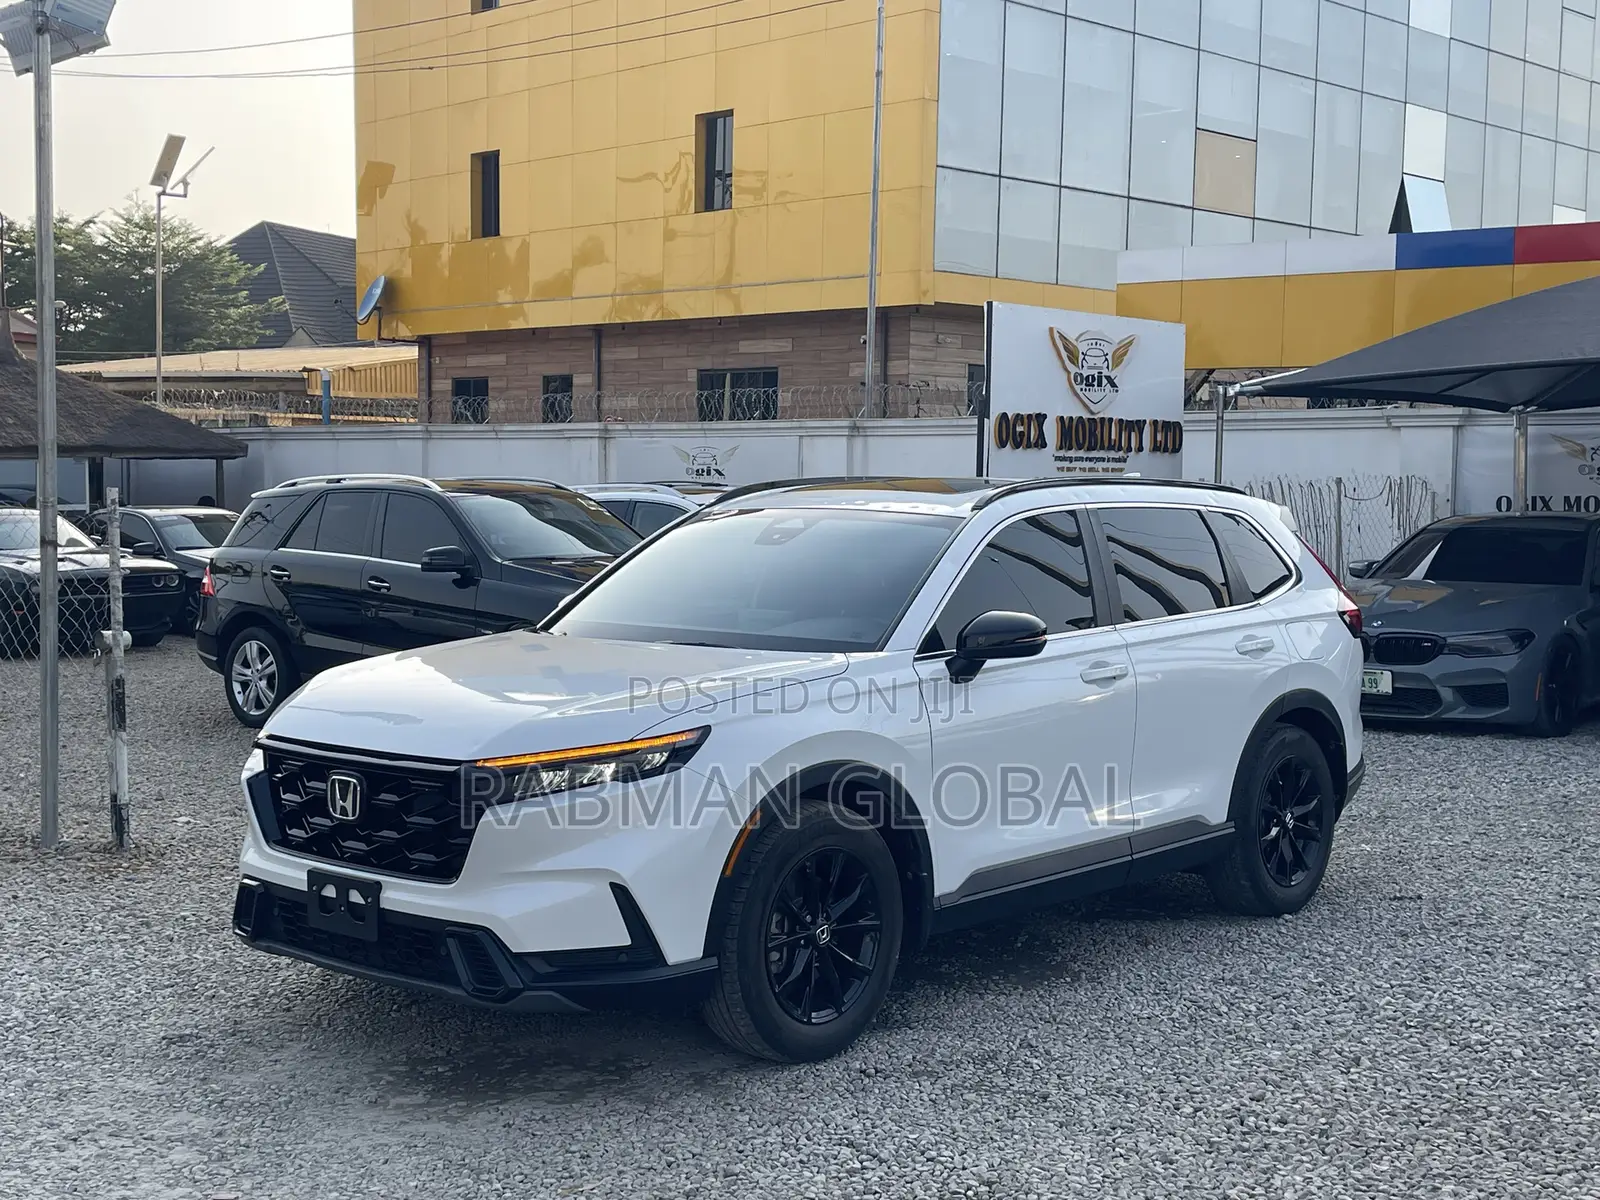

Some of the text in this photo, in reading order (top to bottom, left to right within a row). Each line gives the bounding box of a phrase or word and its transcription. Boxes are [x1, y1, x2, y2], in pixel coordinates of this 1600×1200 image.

[1073, 371, 1119, 388] Ogix
[994, 411, 1184, 453] OGIX MOBILITY LTD
[1496, 495, 1553, 512] OIX
